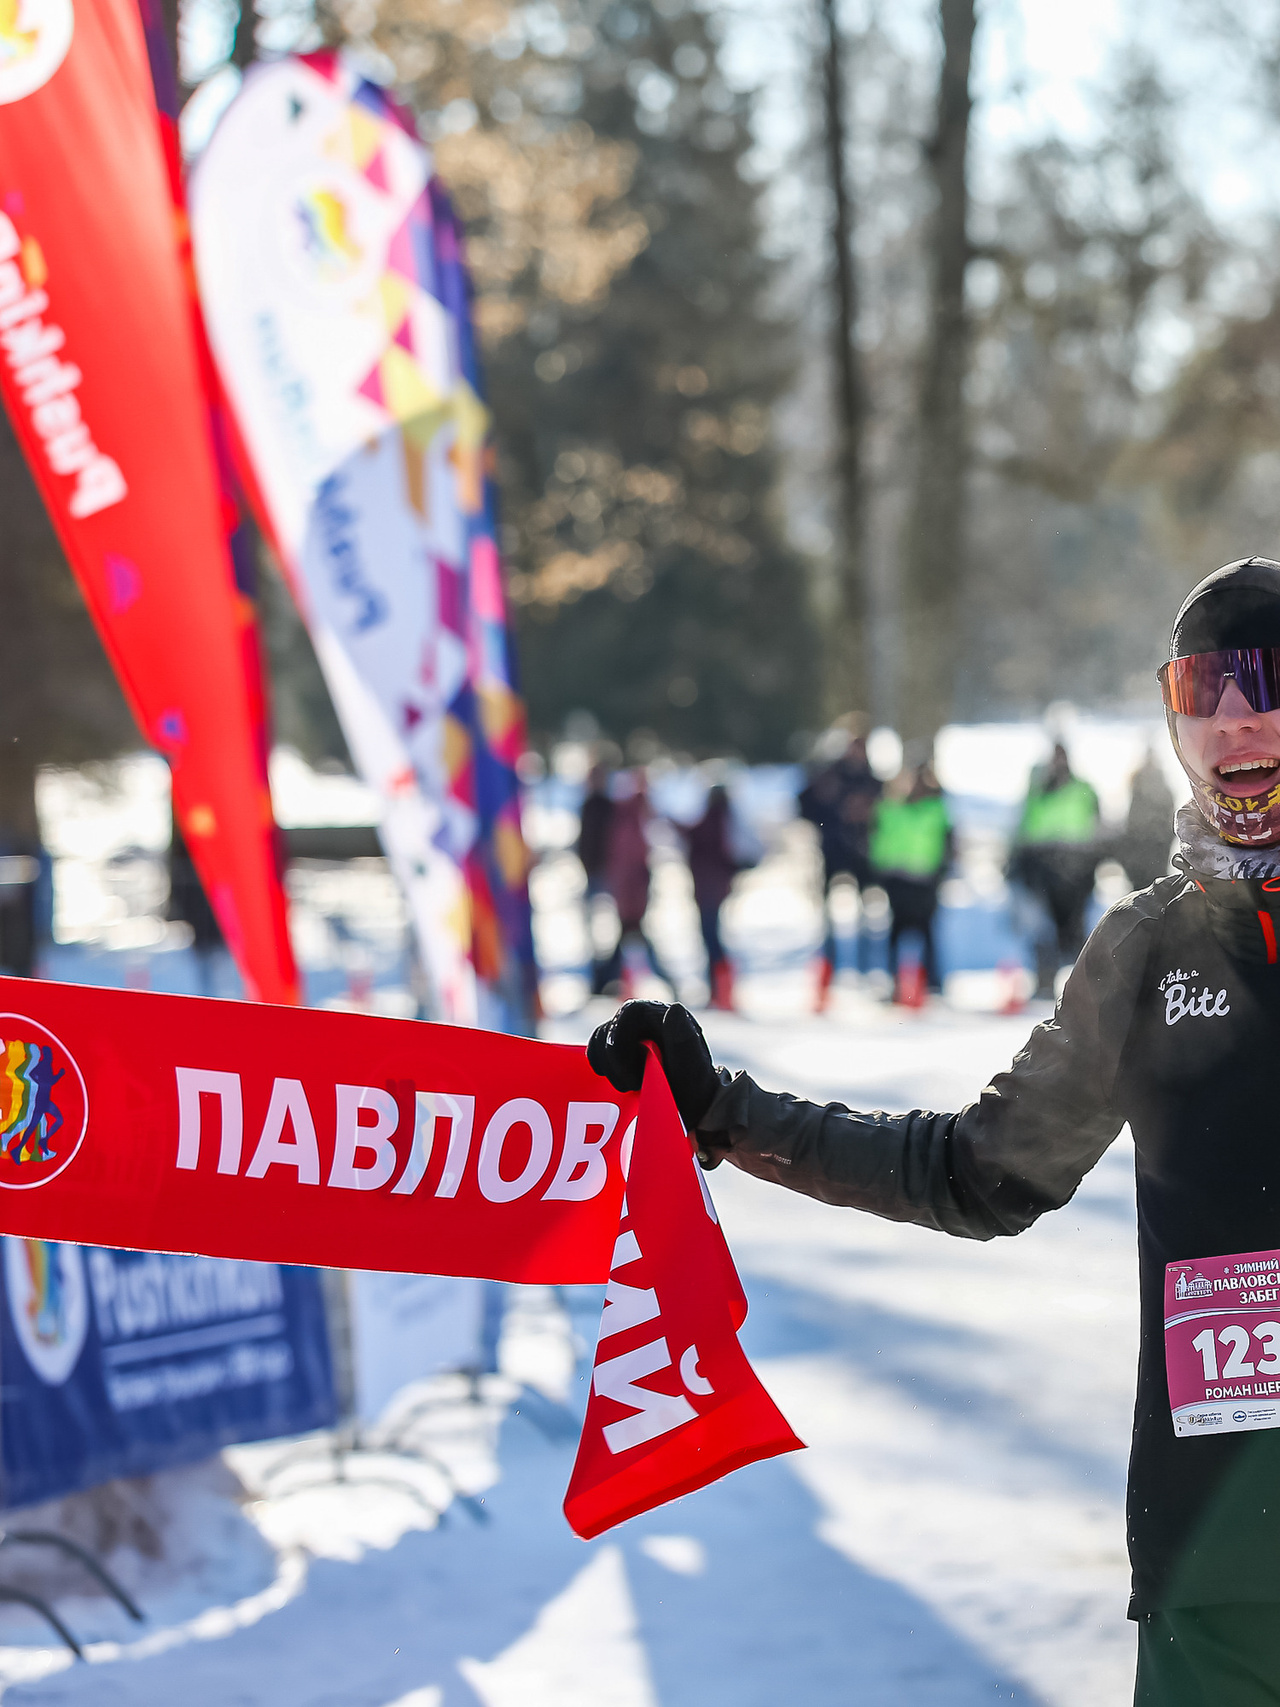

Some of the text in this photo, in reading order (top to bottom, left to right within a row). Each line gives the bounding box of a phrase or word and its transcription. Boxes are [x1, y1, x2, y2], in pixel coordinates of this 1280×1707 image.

[1166, 969, 1190, 984] take
[1164, 983, 1231, 1026] Bite
[175, 1066, 638, 1203] ПАВЛОВ
[1232, 1258, 1280, 1275] ЗИМНИЙ
[1239, 1288, 1280, 1305] ЗАБЕГ
[1204, 1383, 1252, 1400] РОМАН
